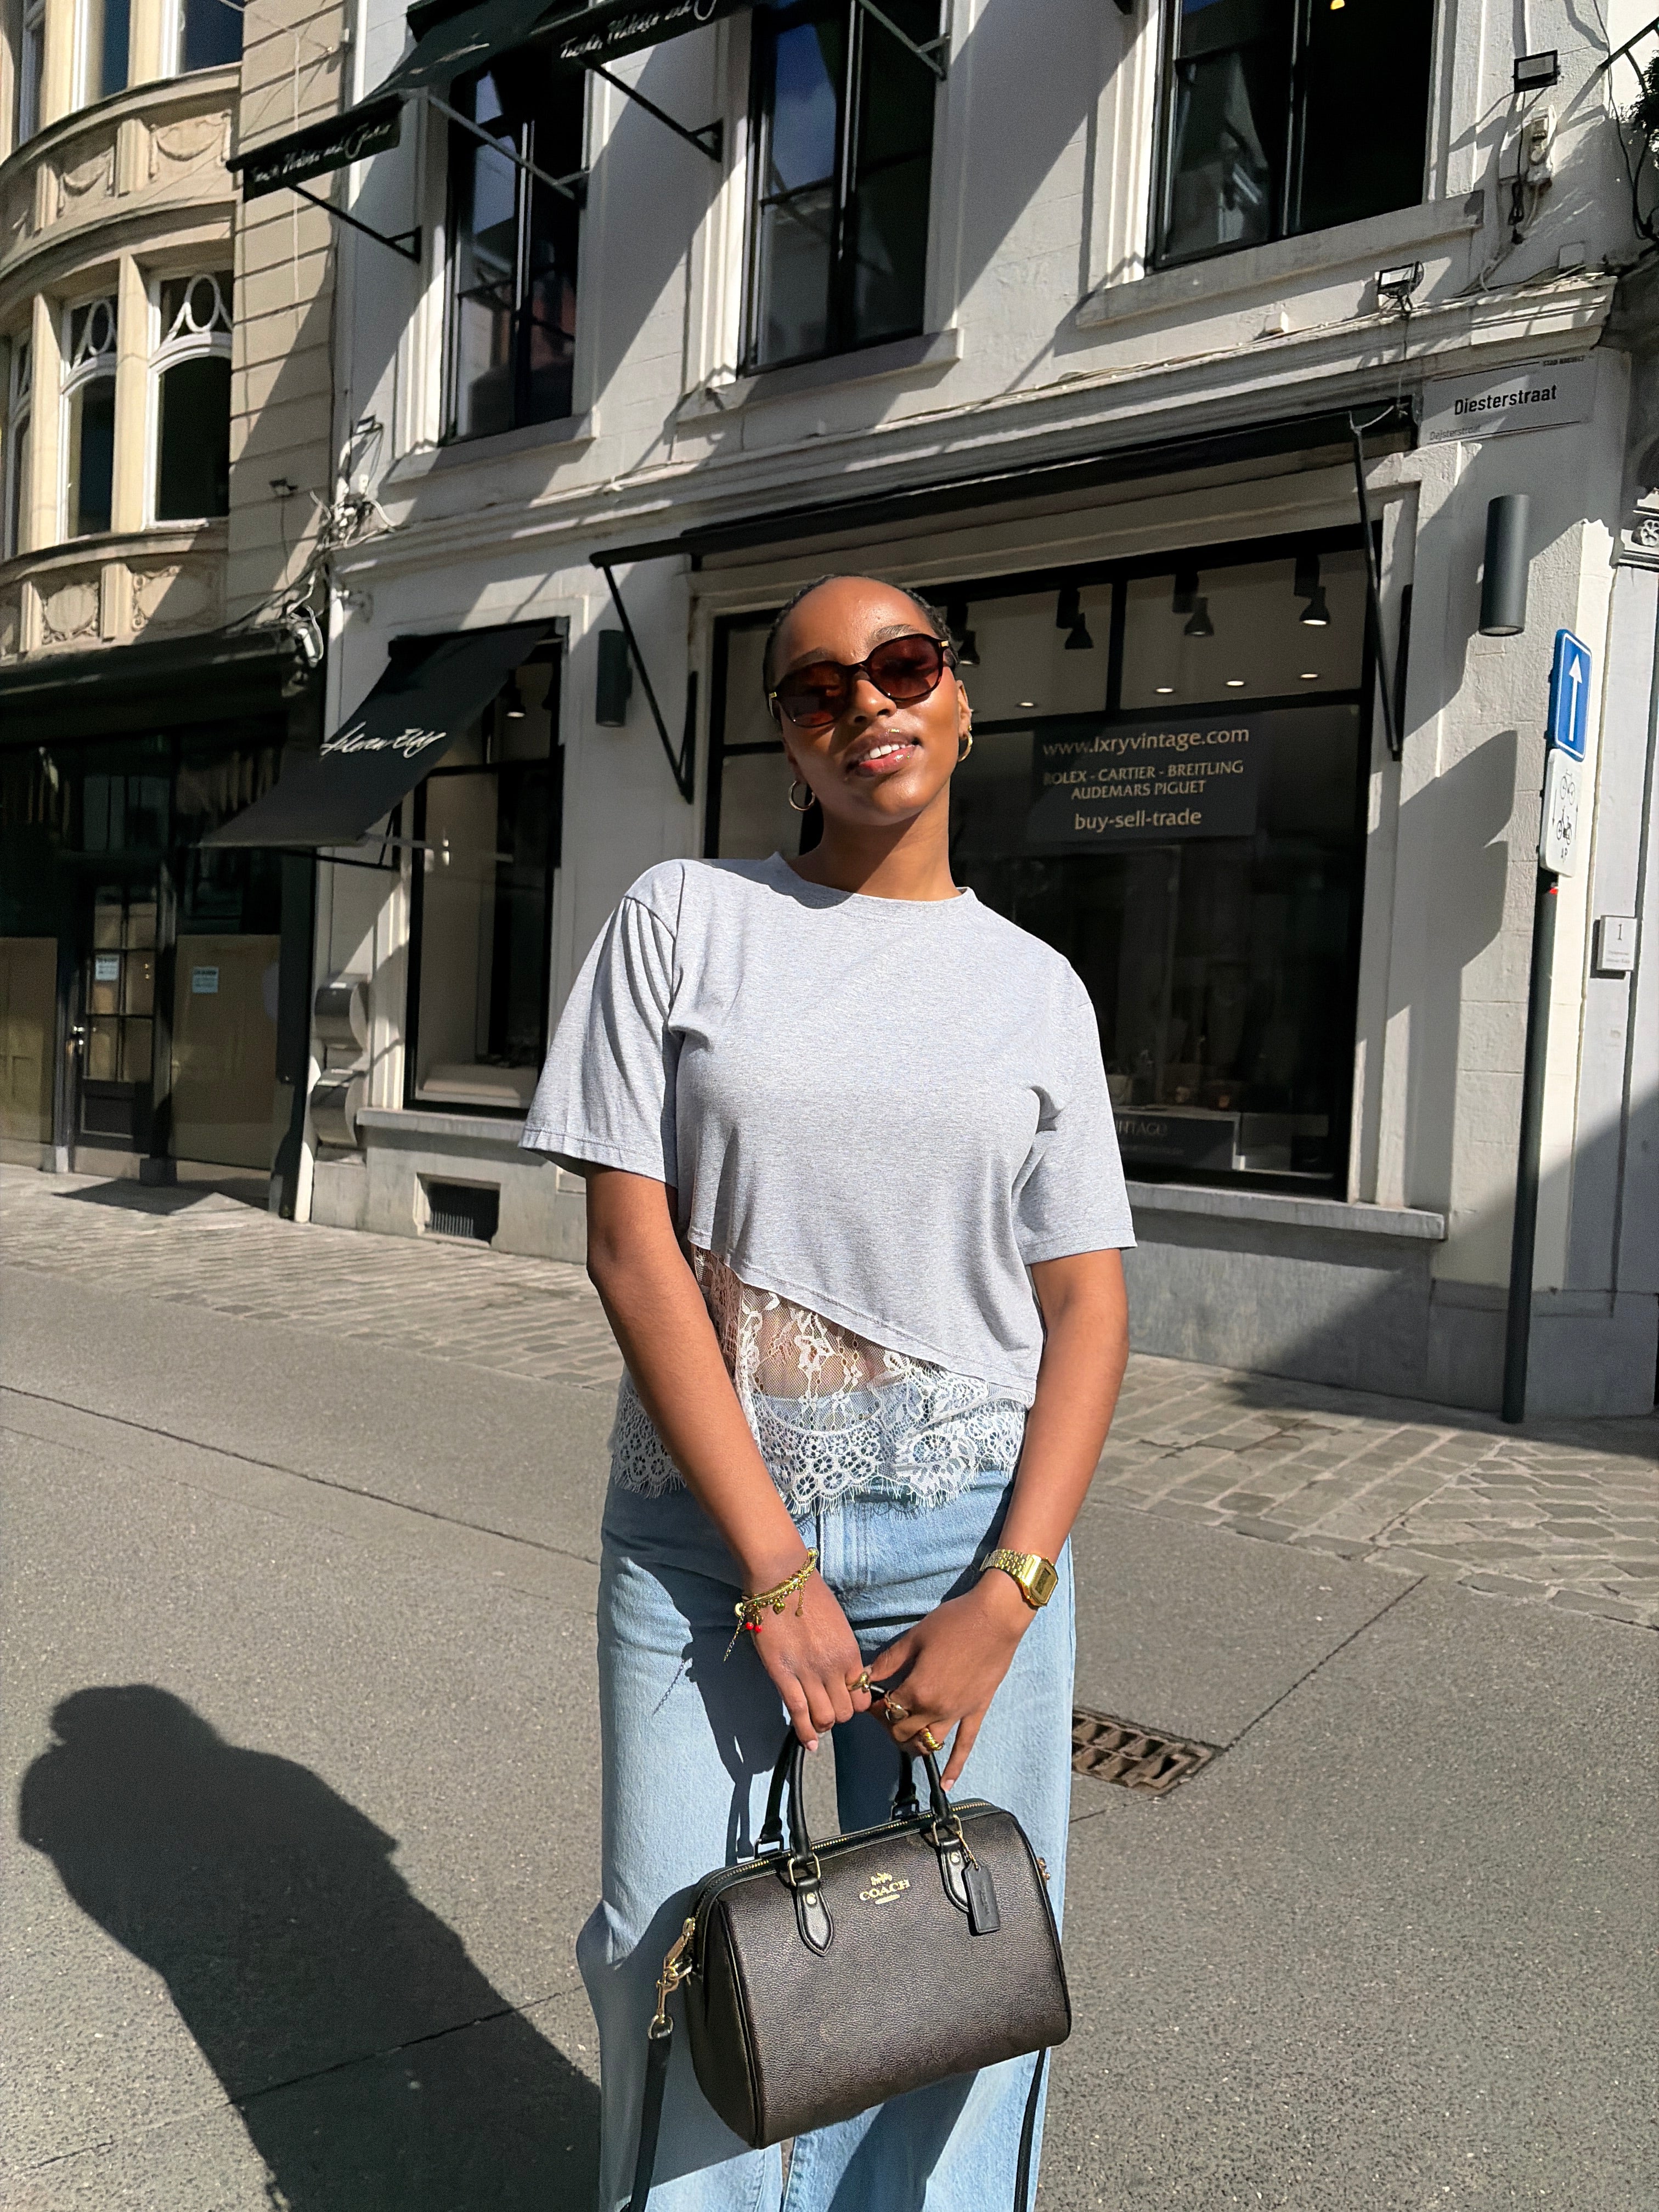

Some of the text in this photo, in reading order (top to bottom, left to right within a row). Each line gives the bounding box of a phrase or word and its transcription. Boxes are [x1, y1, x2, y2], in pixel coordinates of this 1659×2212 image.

[1454, 385, 1558, 415] Diesterstraat
[1043, 728, 1250, 755] www.lxryvintage.com
[1098, 766, 1155, 780] CARTIER
[1167, 760, 1244, 778] BREITLING
[1071, 780, 1206, 800] AUDEMARS PIGUET
[1074, 808, 1202, 833] buy-sell-trade
[859, 1880, 911, 1901] COACH
